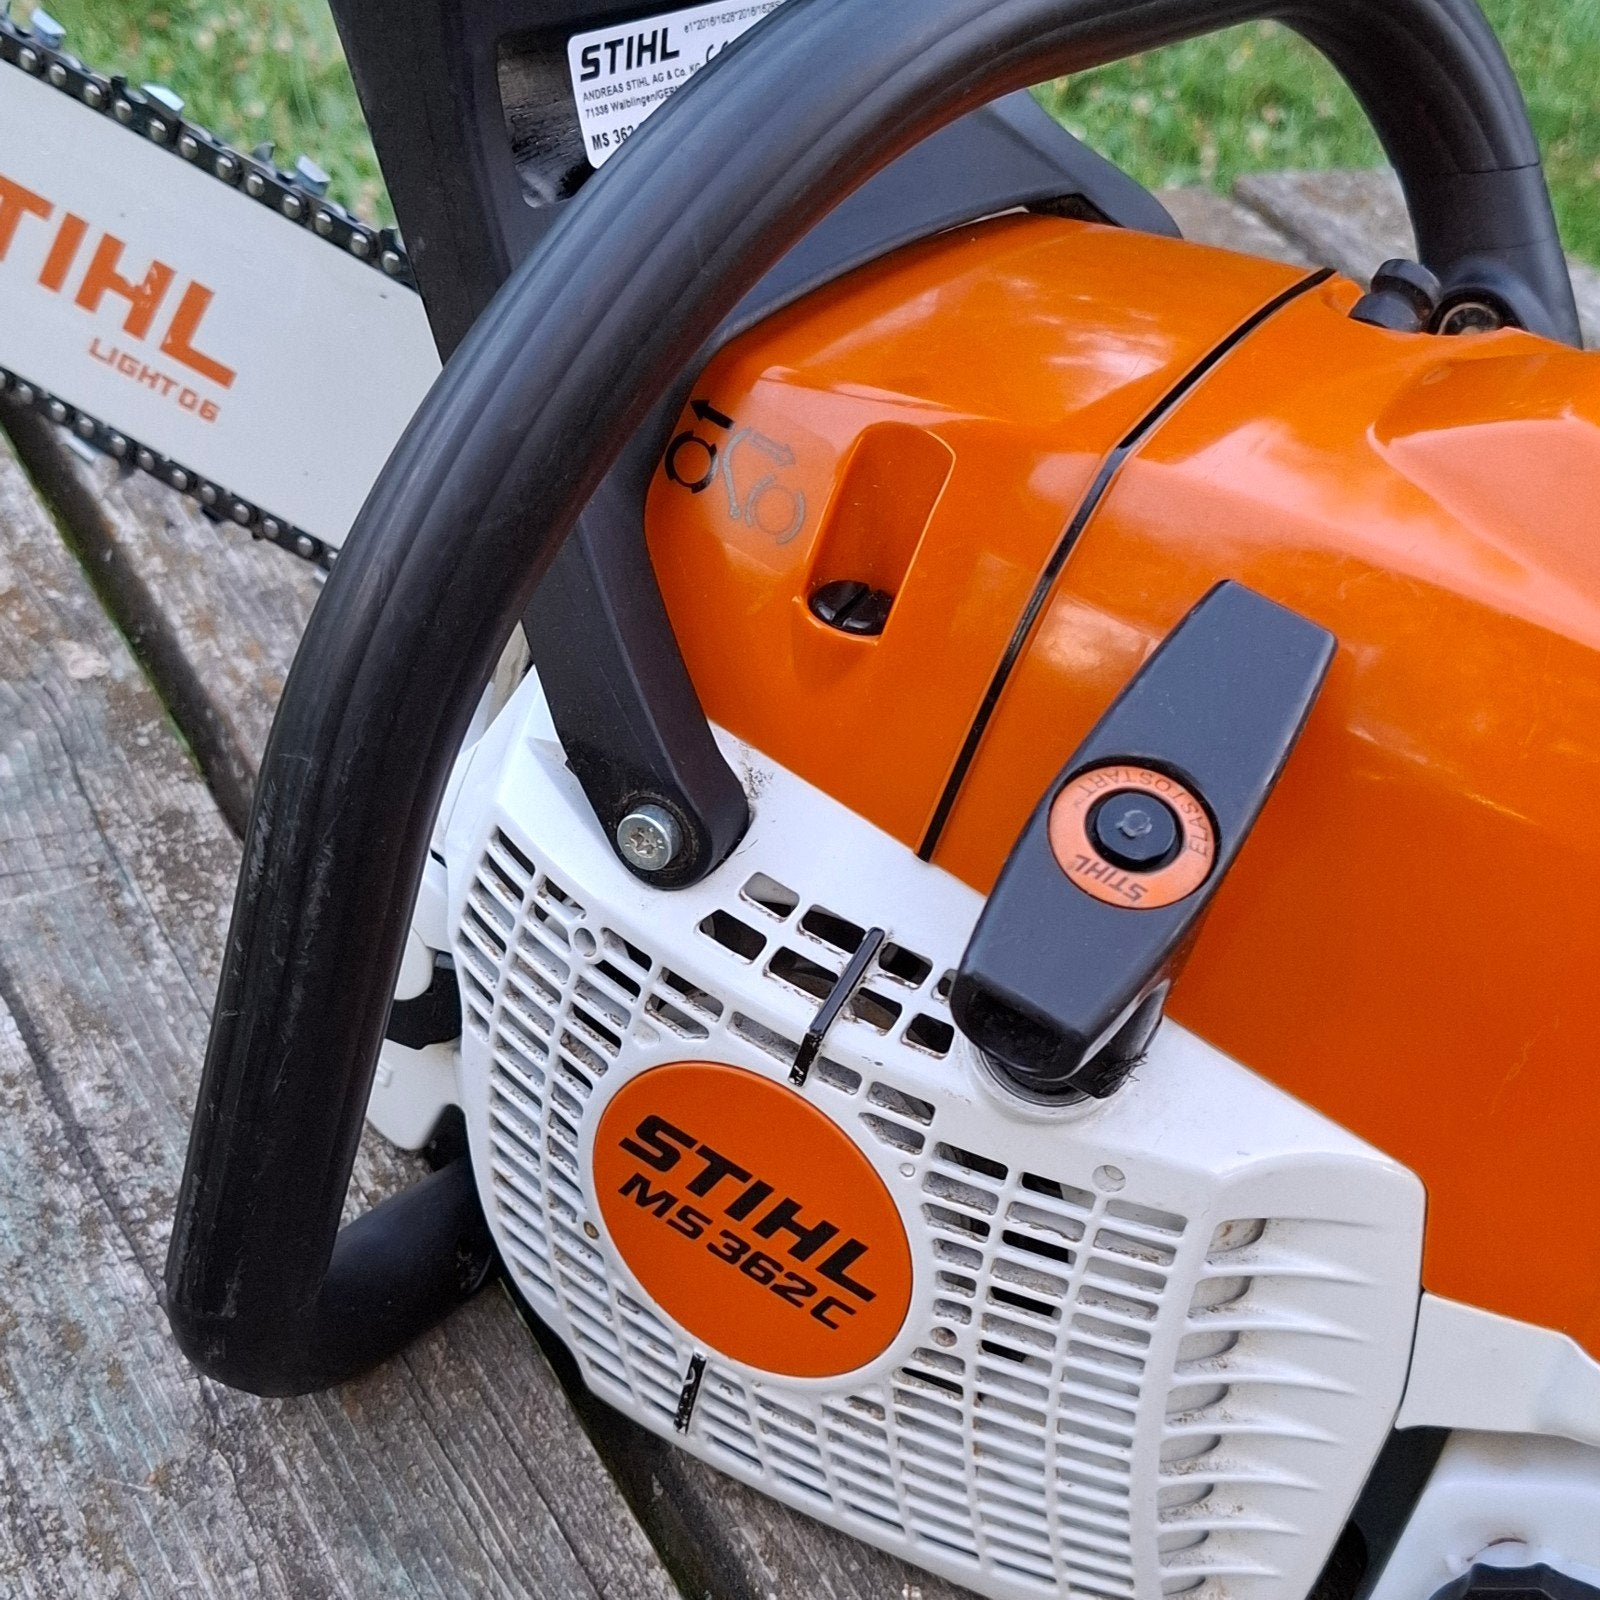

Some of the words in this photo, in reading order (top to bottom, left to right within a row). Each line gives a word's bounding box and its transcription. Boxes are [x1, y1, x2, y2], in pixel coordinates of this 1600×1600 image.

[580, 27, 680, 82] STIHL
[582, 83, 624, 103] ANDREAS
[626, 75, 650, 92] STIHL
[652, 72, 664, 85] AG
[666, 70, 673, 81] &
[611, 84, 681, 112] Waiblingen/GER
[591, 131, 610, 151] MS
[0, 174, 237, 390] TIHL
[1075, 854, 1148, 902] STIHL
[617, 1172, 713, 1240] MS
[618, 1114, 877, 1302] STIHL
